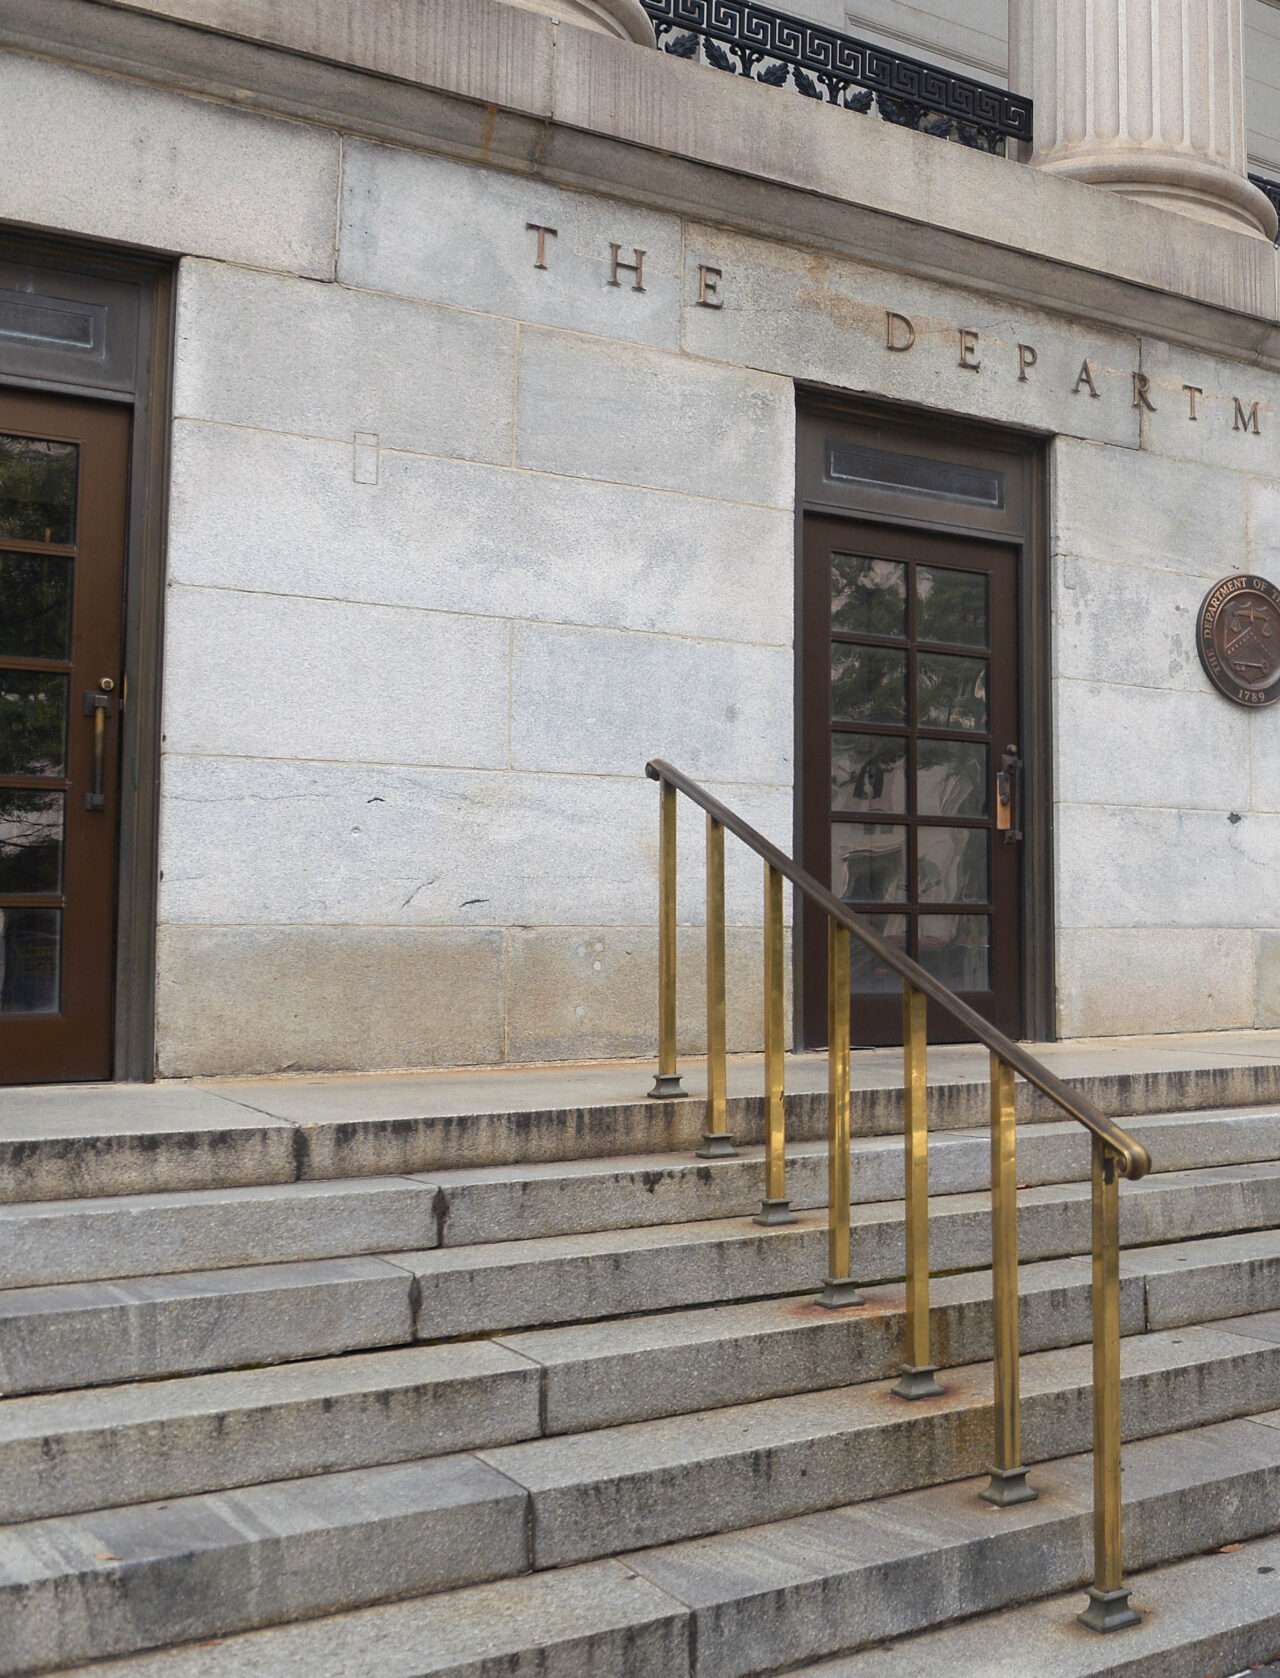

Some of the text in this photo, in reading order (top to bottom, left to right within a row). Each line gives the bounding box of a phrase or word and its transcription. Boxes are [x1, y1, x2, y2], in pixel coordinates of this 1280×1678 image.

[526, 222, 724, 309] THE
[1253, 580, 1268, 592] OF
[1203, 577, 1247, 639] DEPARTMENT
[1206, 648, 1222, 676] THE
[1238, 689, 1265, 702] 1789
